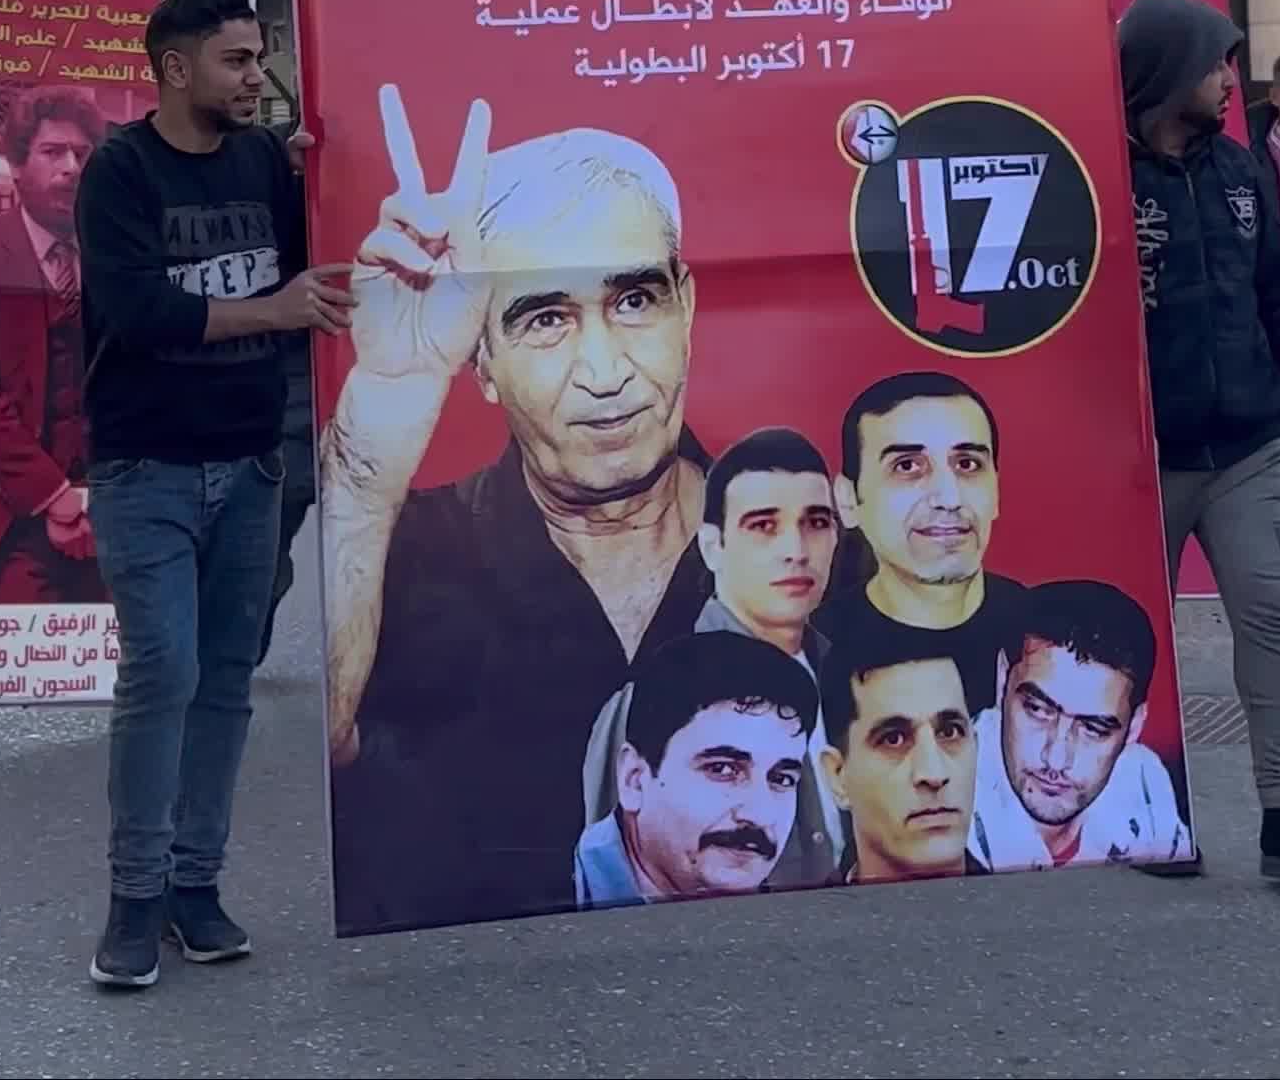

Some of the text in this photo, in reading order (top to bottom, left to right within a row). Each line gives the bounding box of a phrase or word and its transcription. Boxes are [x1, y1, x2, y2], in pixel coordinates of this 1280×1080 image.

[31, 3, 90, 20] لتحرير
[15, 28, 57, 47] علم
[59, 63, 134, 81] الشهيد
[574, 33, 856, 88] 17 أكتوبر البطولية
[168, 214, 267, 246] ALWAYS
[43, 613, 96, 637] الرفيق
[14, 644, 67, 668] النضال
[72, 646, 98, 667] من
[33, 675, 96, 698] السجون
